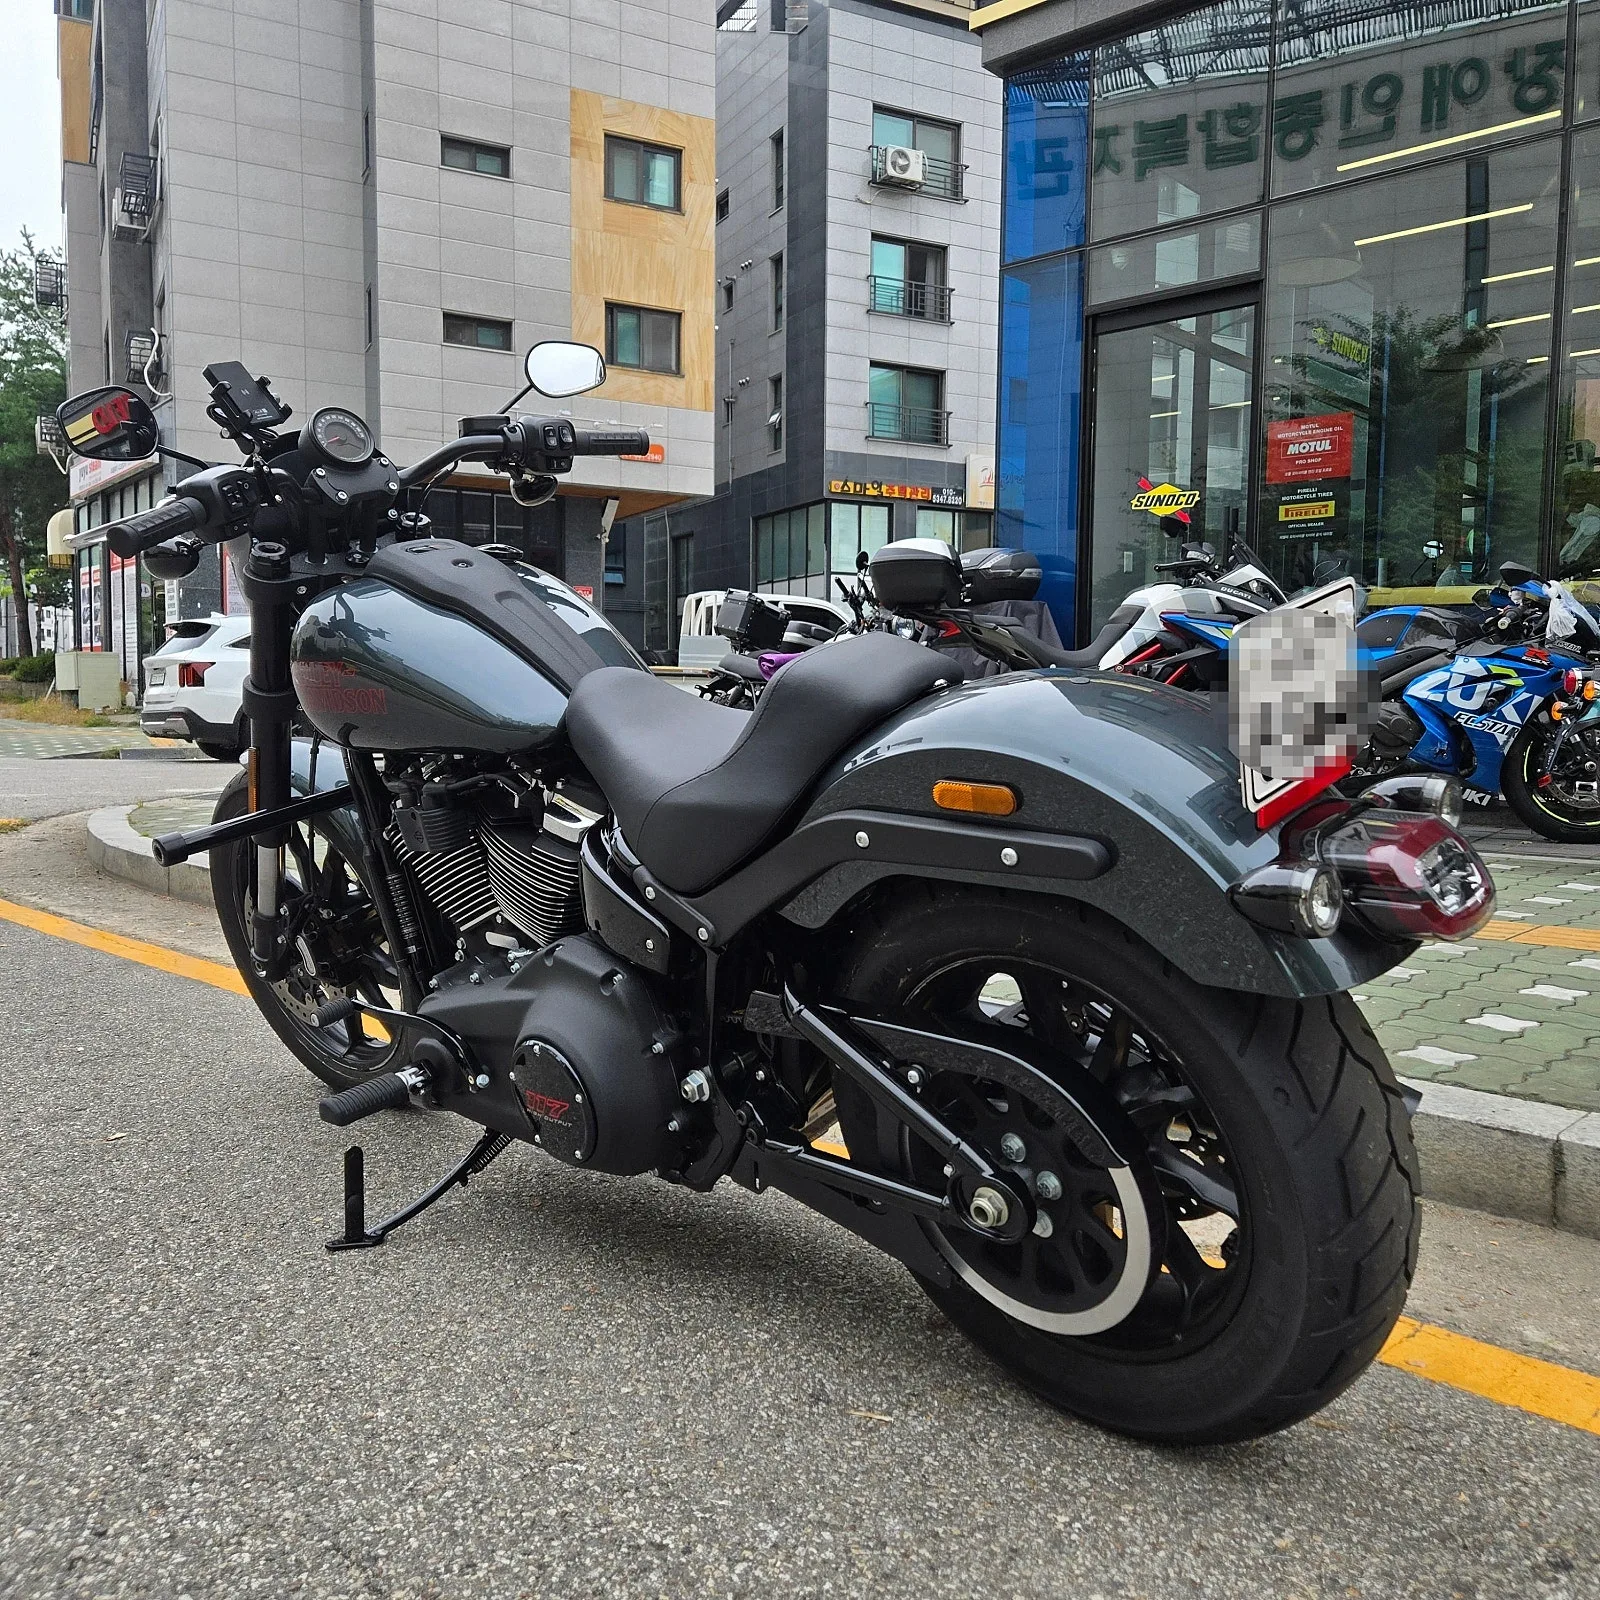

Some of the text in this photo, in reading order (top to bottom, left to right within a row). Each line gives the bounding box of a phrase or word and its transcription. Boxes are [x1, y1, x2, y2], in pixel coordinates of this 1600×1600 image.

[1277, 430, 1312, 439] MOTORCYCLE
[1312, 427, 1333, 435] ENGINE
[1286, 439, 1332, 455] MOTUL
[1133, 492, 1197, 508] SUNOCO
[1281, 493, 1317, 501] MOTORCYCLE
[1284, 503, 1330, 518] PIRELLI
[1220, 586, 1252, 600] DUCATI
[525, 1090, 569, 1119] 117
[543, 1115, 573, 1128] OUTPUT
